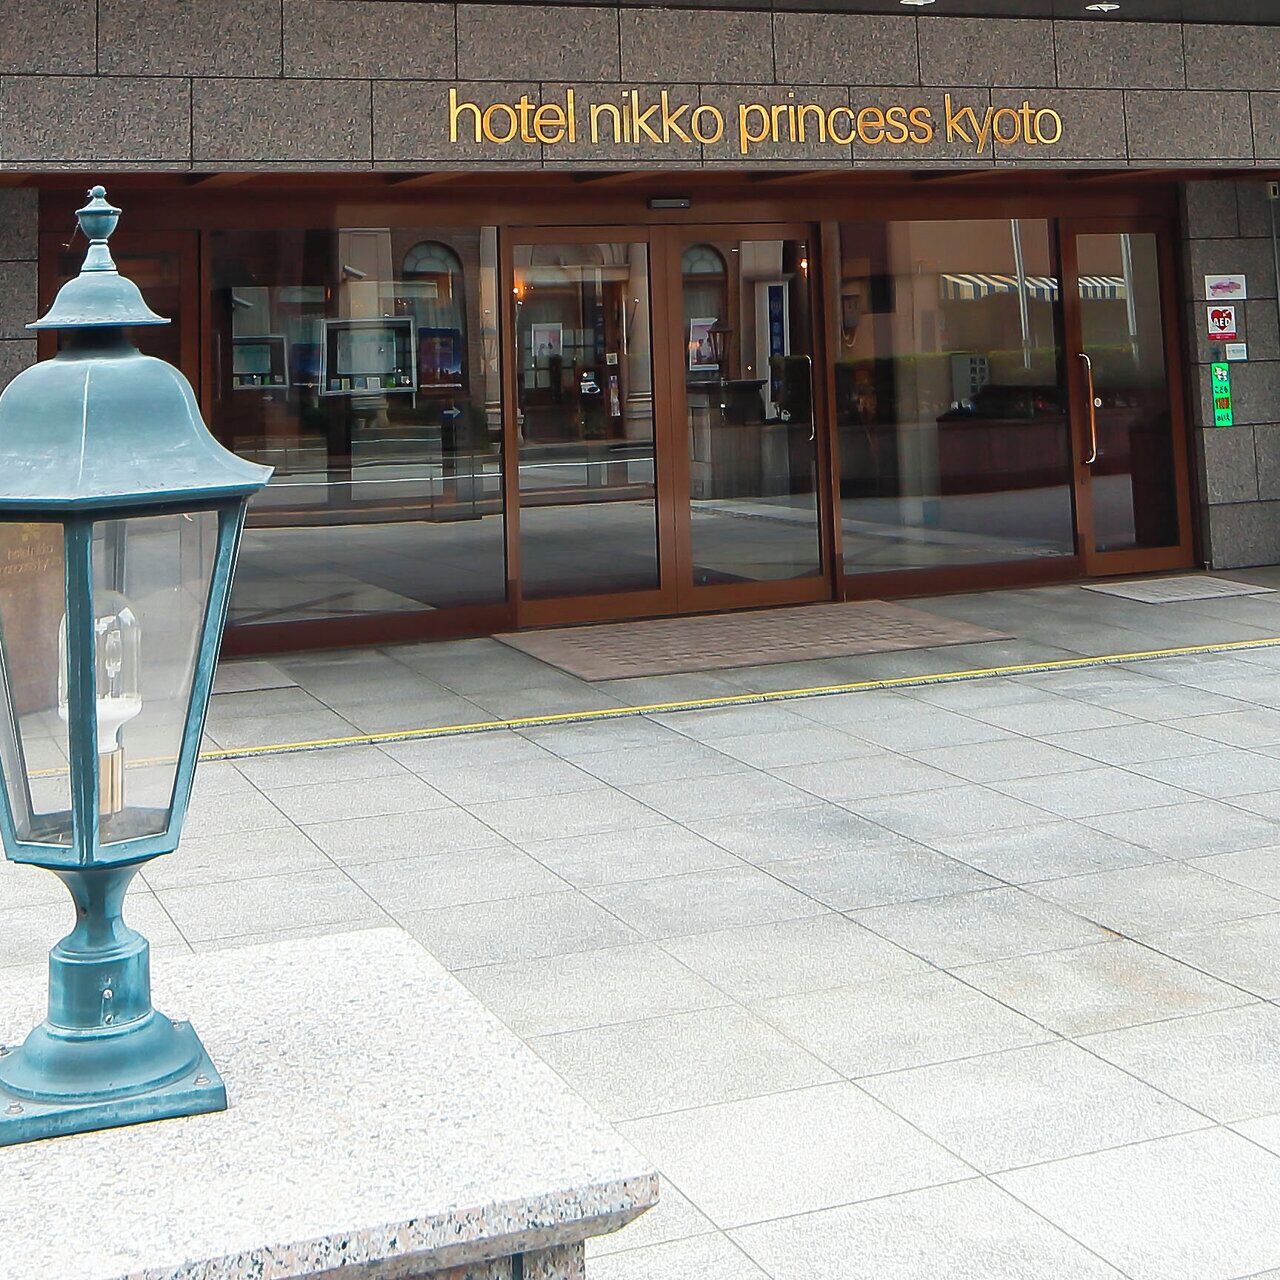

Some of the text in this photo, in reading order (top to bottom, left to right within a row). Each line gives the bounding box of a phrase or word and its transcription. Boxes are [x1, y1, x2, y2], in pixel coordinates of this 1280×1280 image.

[449, 88, 1063, 155] hotel nikko princess kyoto
[1213, 317, 1231, 327] AED
